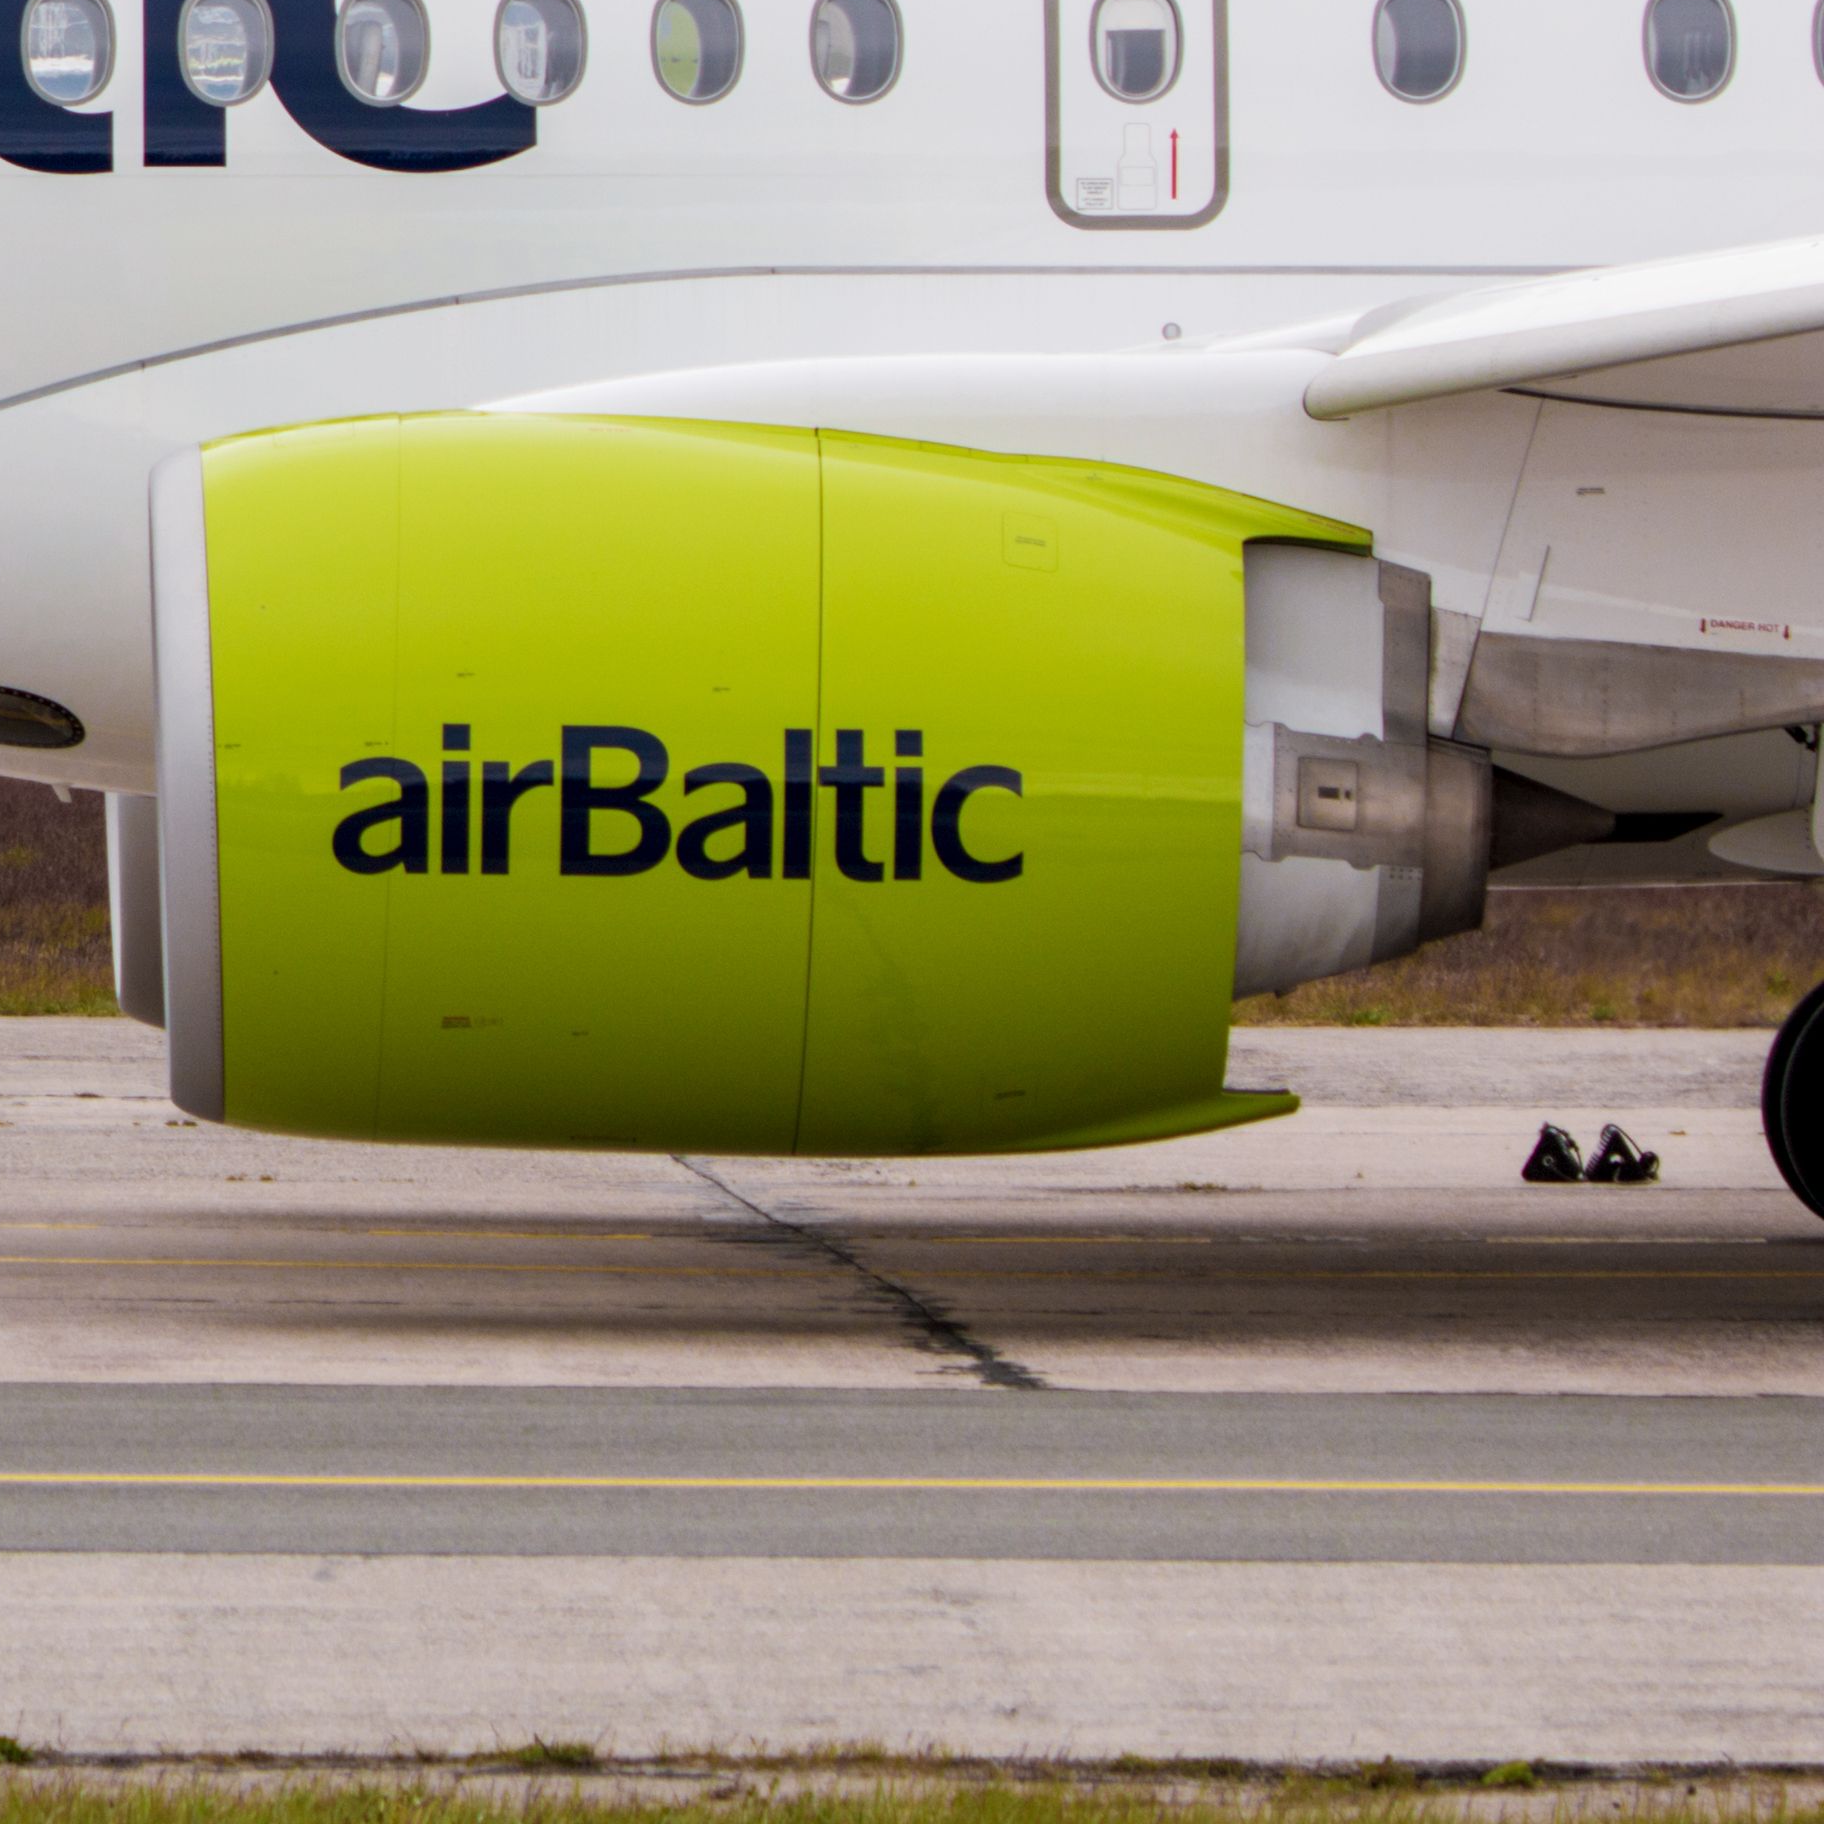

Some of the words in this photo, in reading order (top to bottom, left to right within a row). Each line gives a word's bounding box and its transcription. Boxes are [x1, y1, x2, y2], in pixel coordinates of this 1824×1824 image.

[1710, 619, 1756, 631] DANGER
[1758, 623, 1780, 633] HOT
[332, 724, 1024, 883] airBaltic
